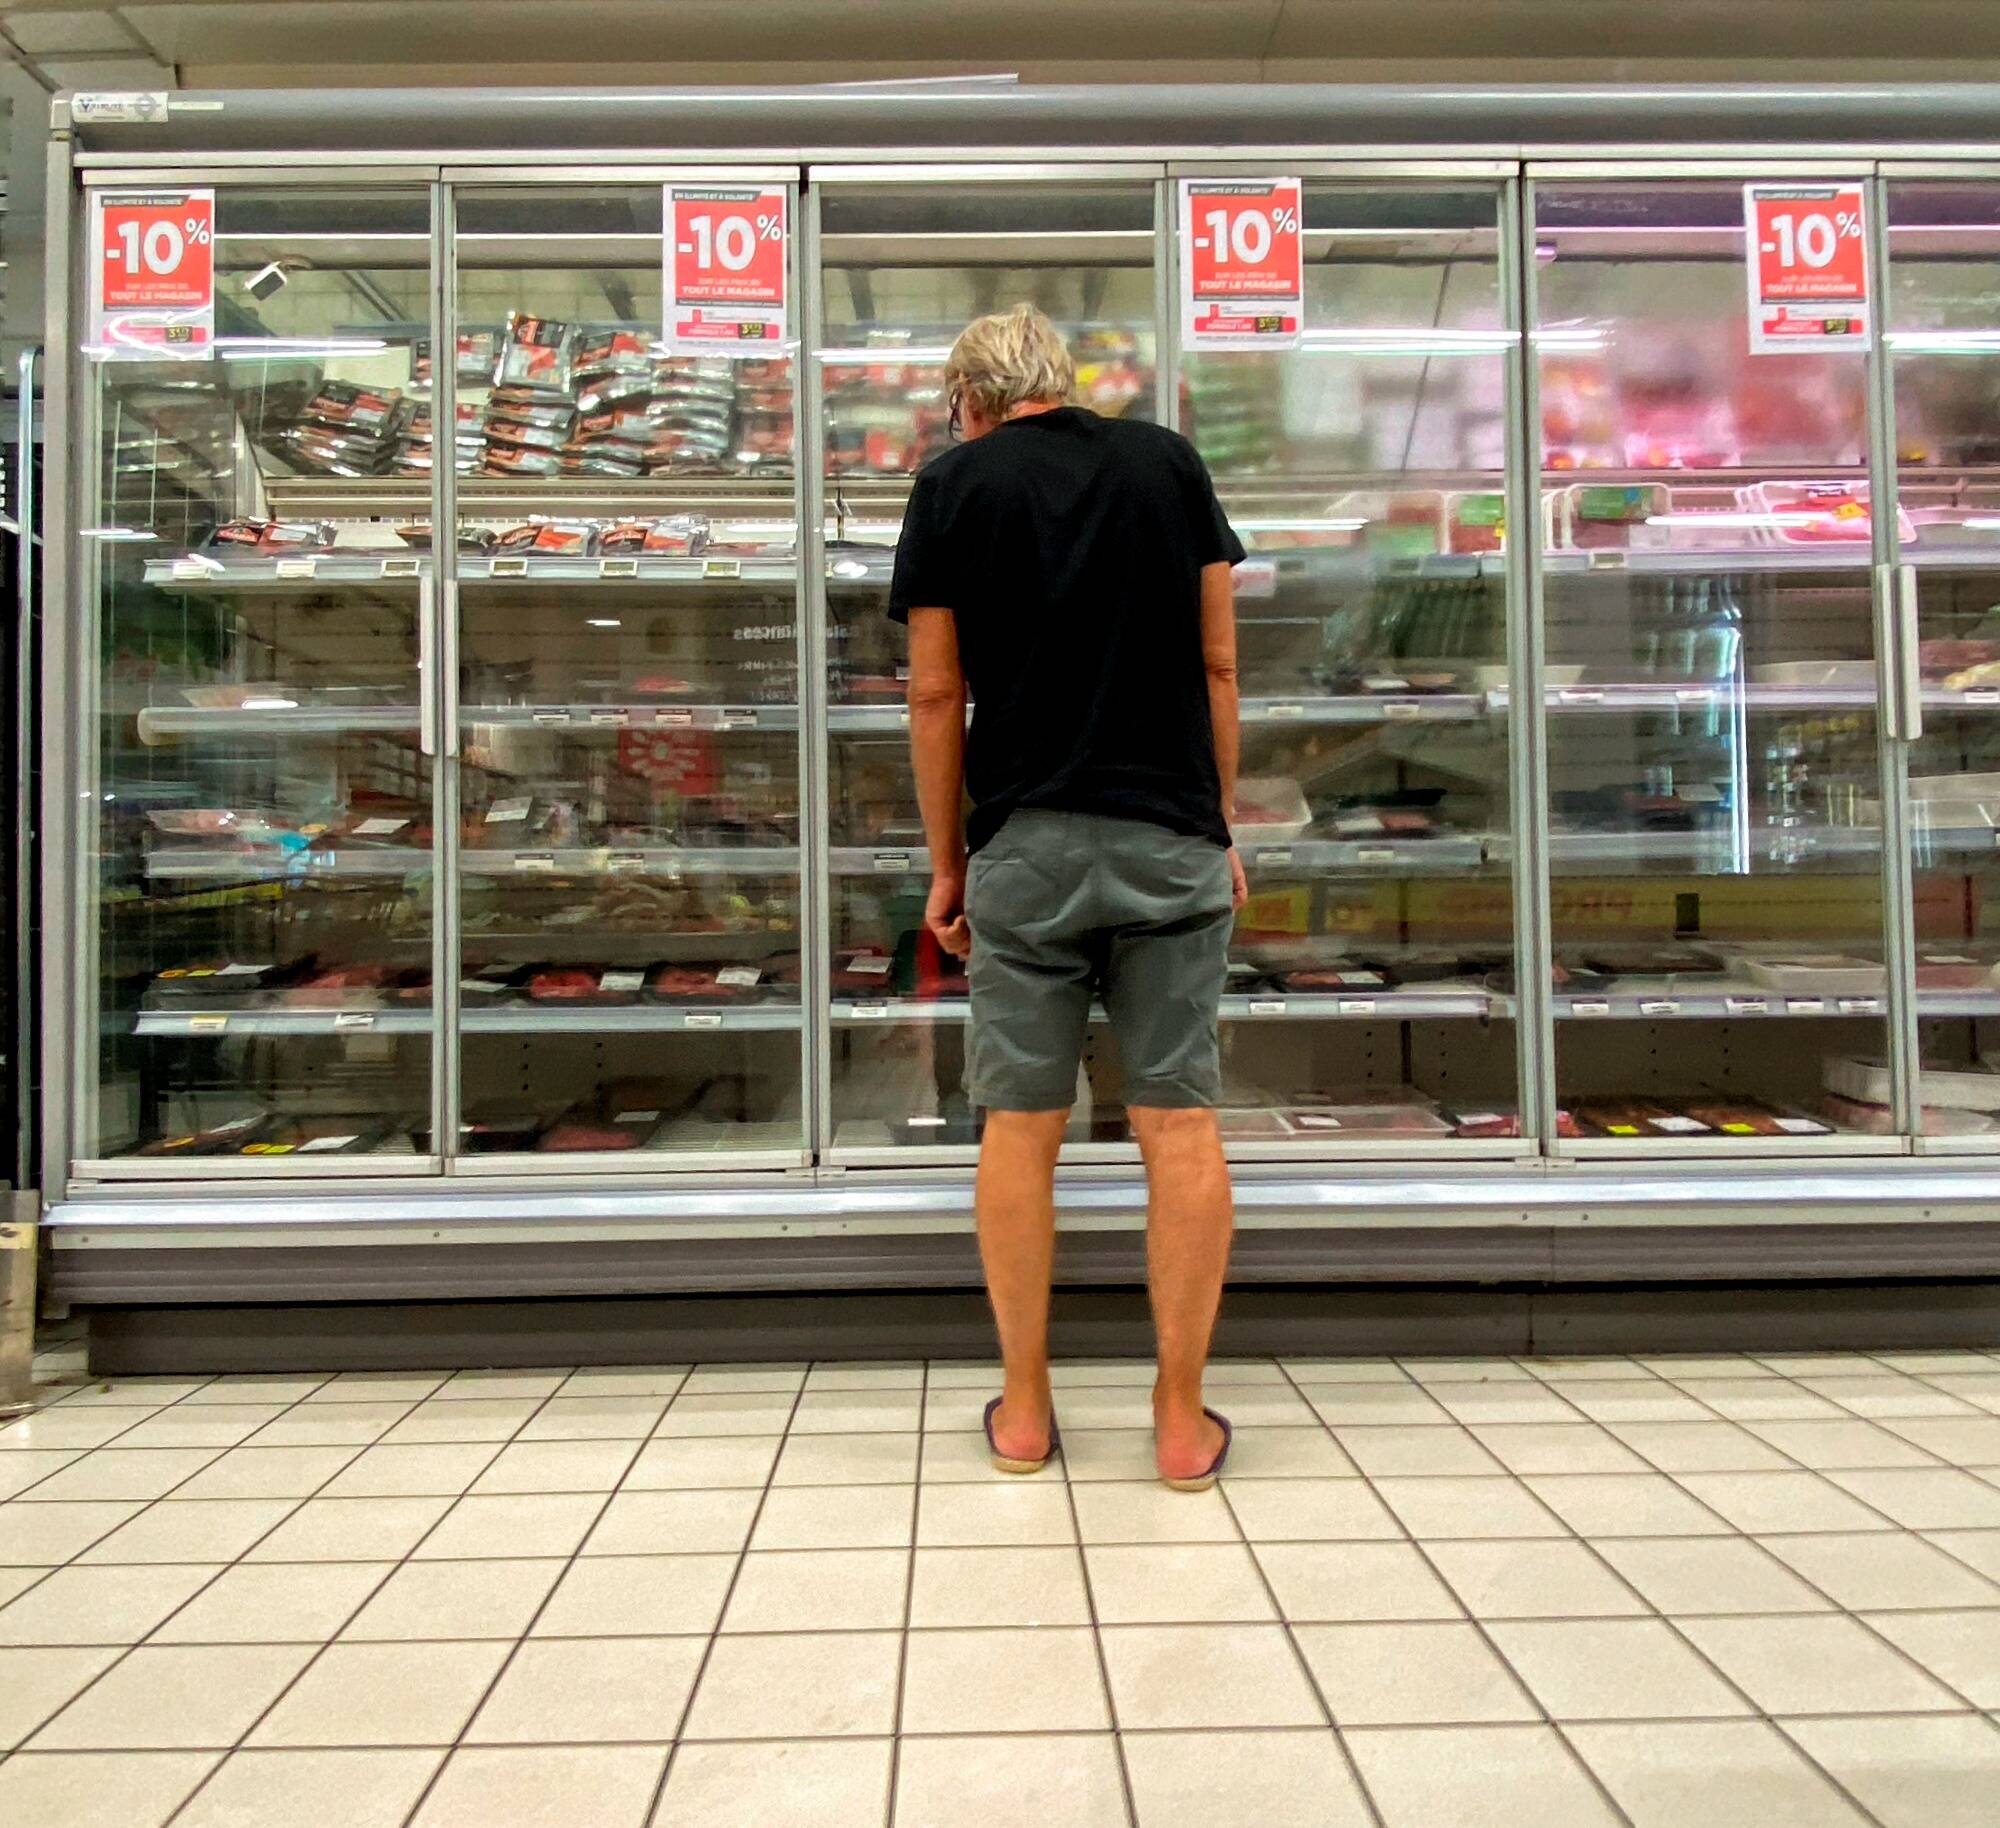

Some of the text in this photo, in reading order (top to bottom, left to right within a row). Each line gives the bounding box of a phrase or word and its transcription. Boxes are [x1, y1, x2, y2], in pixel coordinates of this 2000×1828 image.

[106, 217, 210, 275] -10%
[678, 214, 781, 270] -10%
[1195, 207, 1297, 264] -10%
[1761, 211, 1861, 268] -10%
[110, 291, 137, 300] TOUT
[682, 286, 775, 296] TOUT LE MAGASIN
[1200, 280, 1292, 289] TOUT LE MAGASIN
